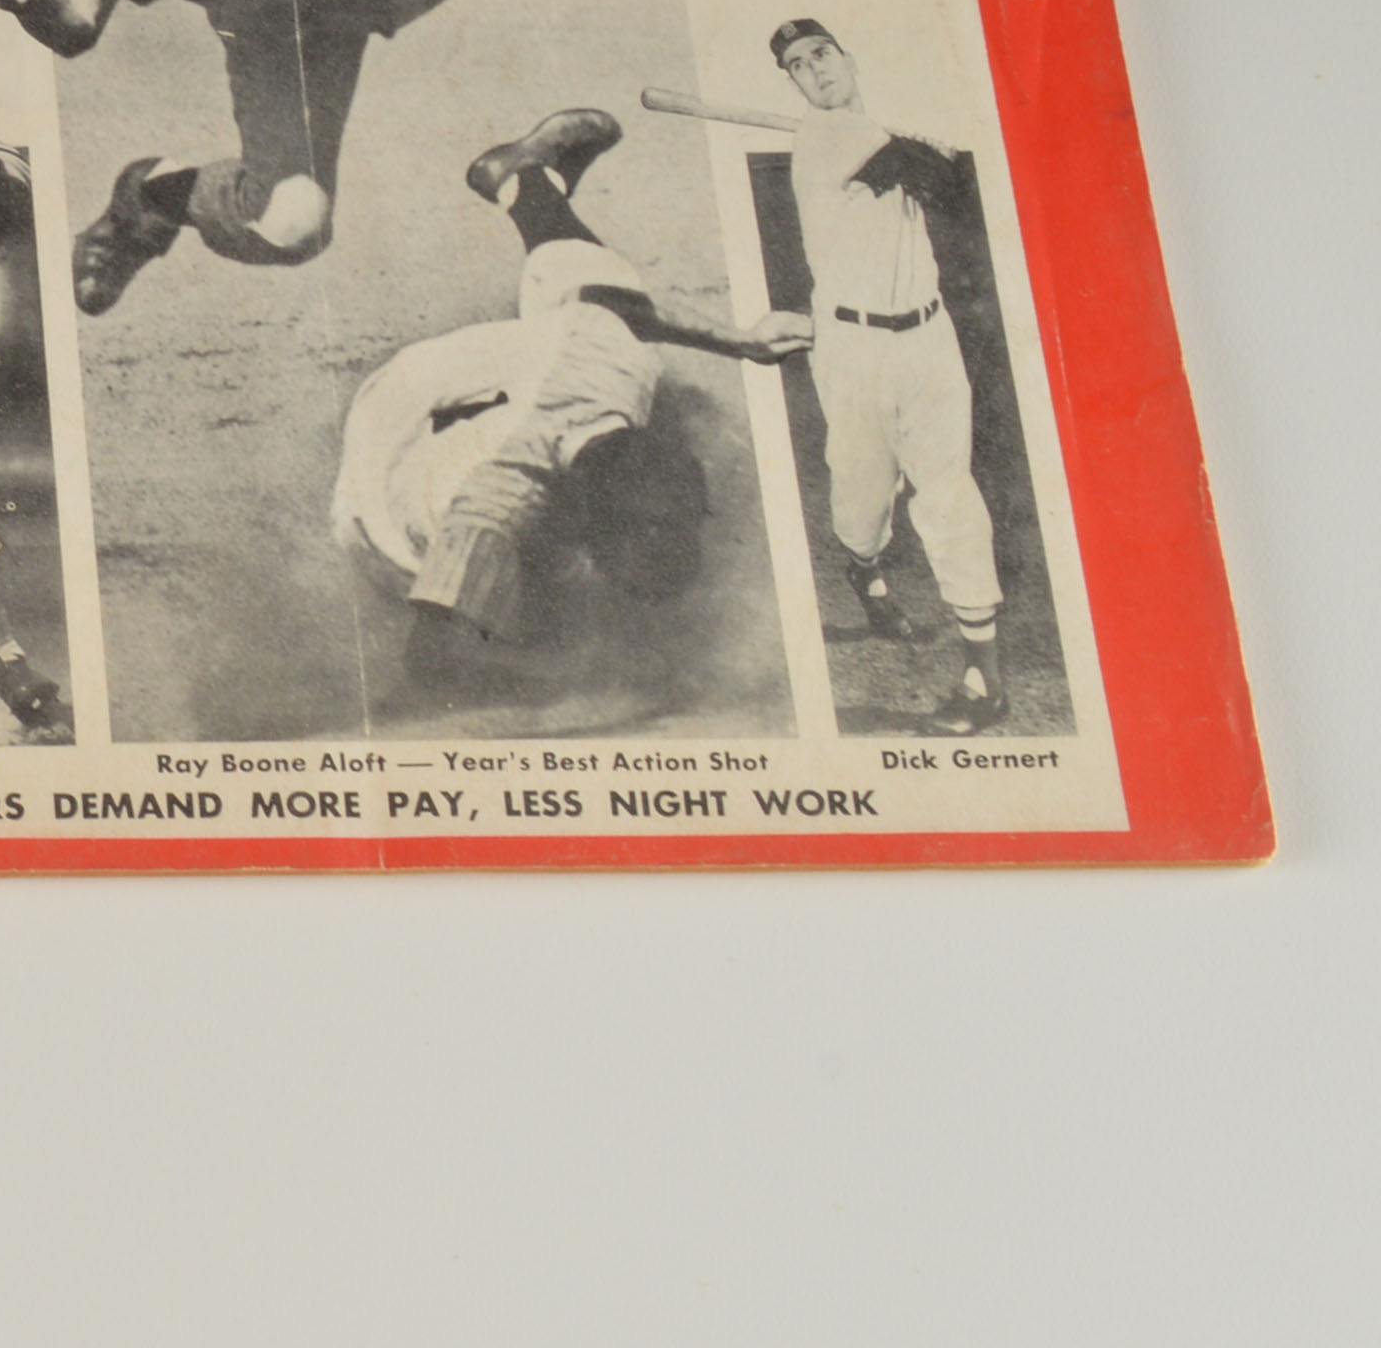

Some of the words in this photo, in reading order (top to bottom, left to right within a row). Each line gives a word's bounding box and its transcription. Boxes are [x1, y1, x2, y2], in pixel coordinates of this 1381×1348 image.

[157, 755, 208, 778] Ray
[222, 754, 307, 773] Boone
[319, 753, 387, 773] Aloft
[443, 752, 531, 771] Year's
[543, 752, 599, 771] Best
[612, 752, 696, 771] Action
[709, 751, 768, 771] Shot
[881, 750, 939, 769] Dick
[952, 749, 1060, 769] Gernert
[53, 792, 223, 820] DEMAND
[251, 792, 362, 818] MORE
[388, 791, 480, 821] PAY,
[504, 790, 583, 817] LESS
[610, 790, 727, 817] NIGHT
[753, 789, 879, 817] WORK
